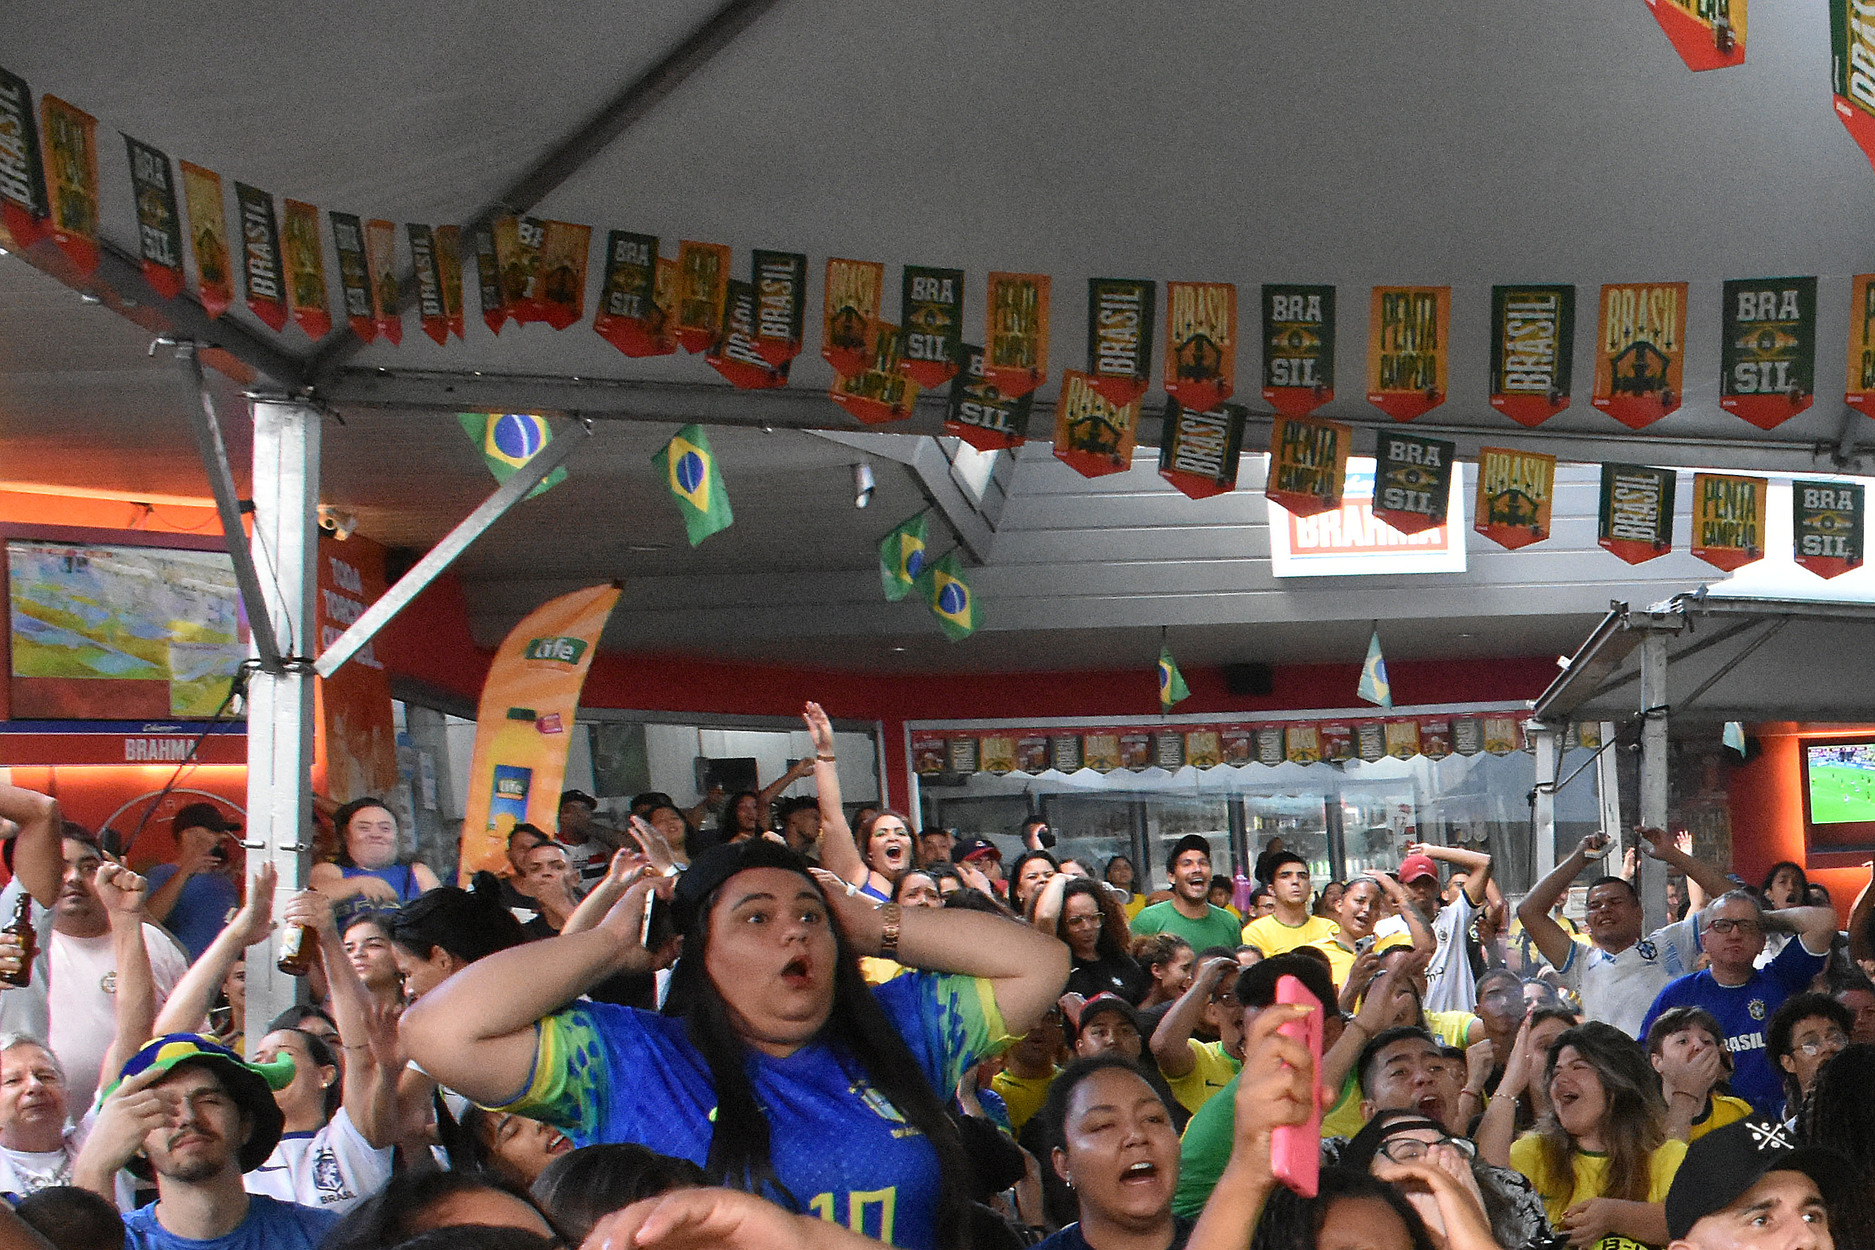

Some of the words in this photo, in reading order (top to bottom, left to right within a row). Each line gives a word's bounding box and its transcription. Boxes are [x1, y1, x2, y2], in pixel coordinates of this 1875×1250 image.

[245, 201, 278, 298] BRASIL
[760, 260, 794, 338] BRASIL
[911, 276, 953, 302] BRA
[1272, 296, 1322, 322] BRA
[1605, 287, 1678, 351] BRASIL
[1737, 290, 1800, 321] BRA
[1100, 285, 1141, 375] BRASIL
[1505, 296, 1556, 392] BRASIL
[907, 333, 949, 361] SIL
[1272, 359, 1321, 387] SIL
[1734, 361, 1794, 393] SIL
[960, 402, 1014, 429] SIL
[1389, 440, 1441, 468] BRA
[1484, 453, 1547, 501] BRASIL
[1383, 487, 1434, 514] SIL
[1612, 472, 1660, 539] BRASIL
[1703, 477, 1756, 521] PENTA
[1803, 489, 1853, 510] BRA
[1802, 534, 1852, 557] SIL
[125, 738, 197, 761] BRAHMA
[1723, 1031, 1767, 1053] RASIL
